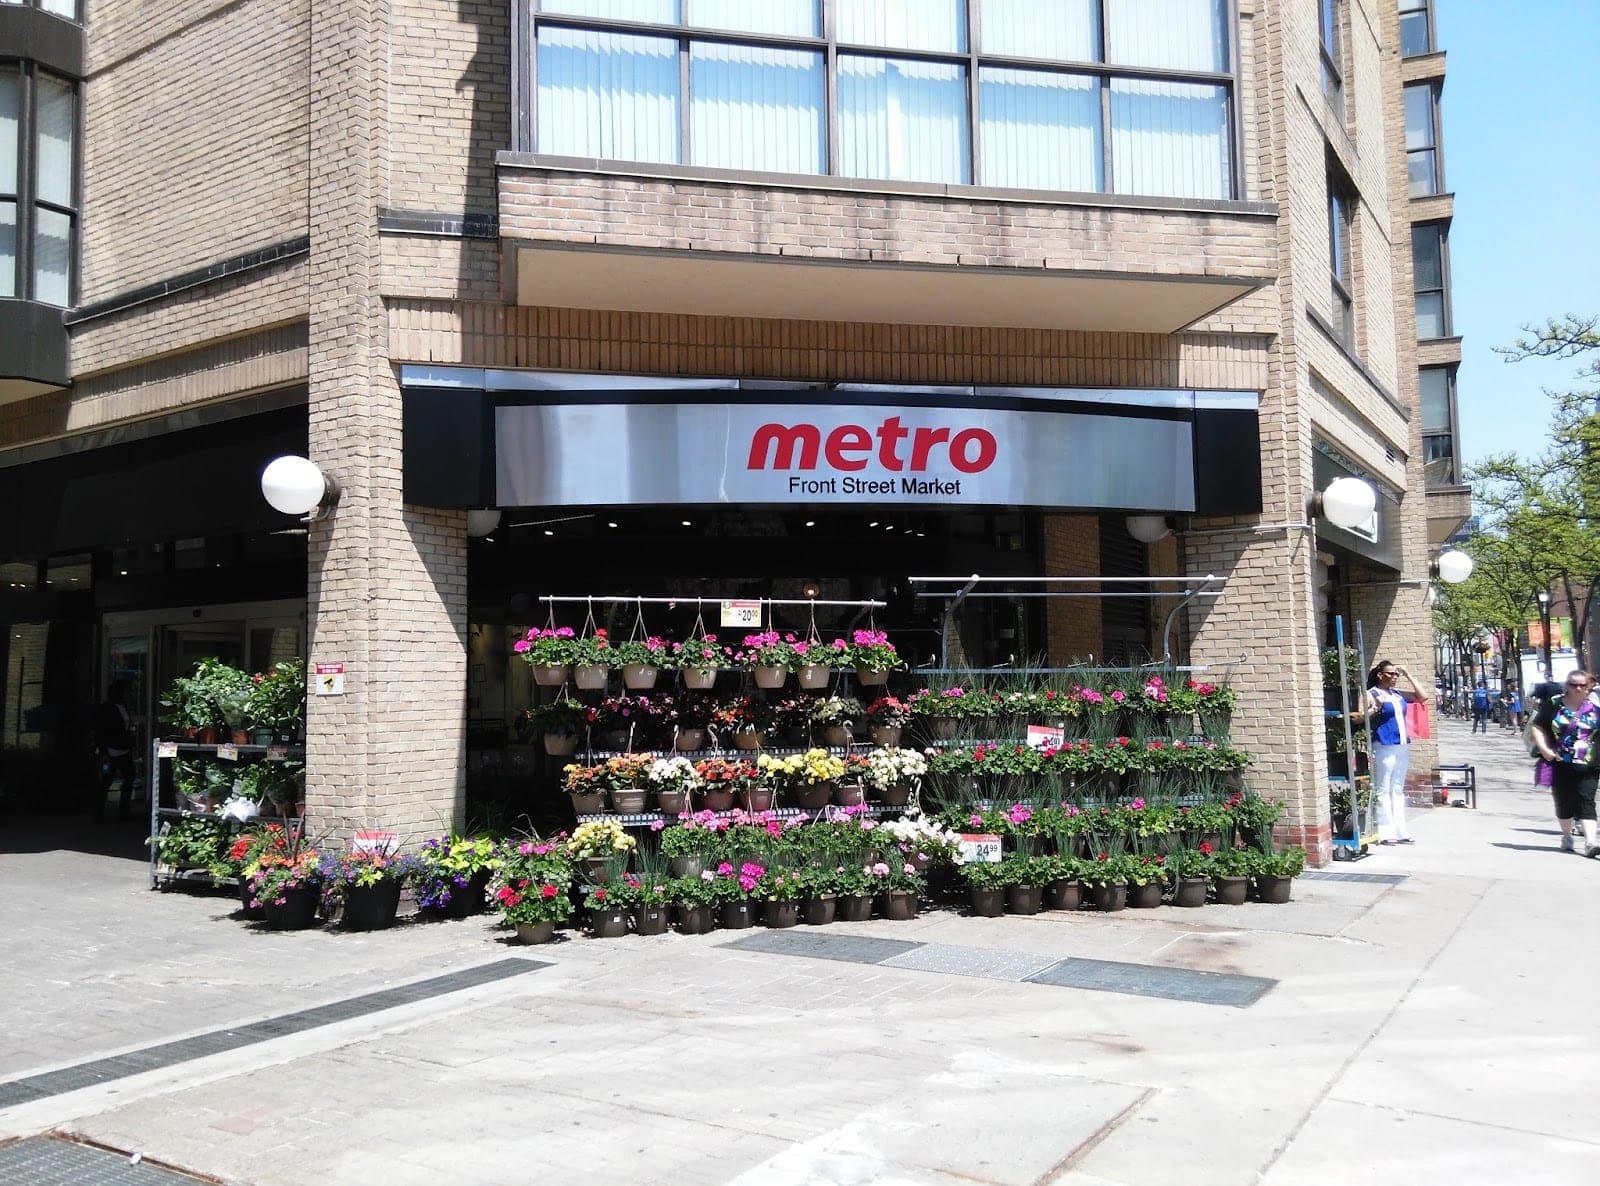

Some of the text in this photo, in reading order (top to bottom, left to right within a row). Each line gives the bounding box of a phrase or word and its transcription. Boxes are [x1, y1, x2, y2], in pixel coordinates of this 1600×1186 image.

[747, 416, 998, 474] metro
[789, 477, 961, 495] Front Street Market
